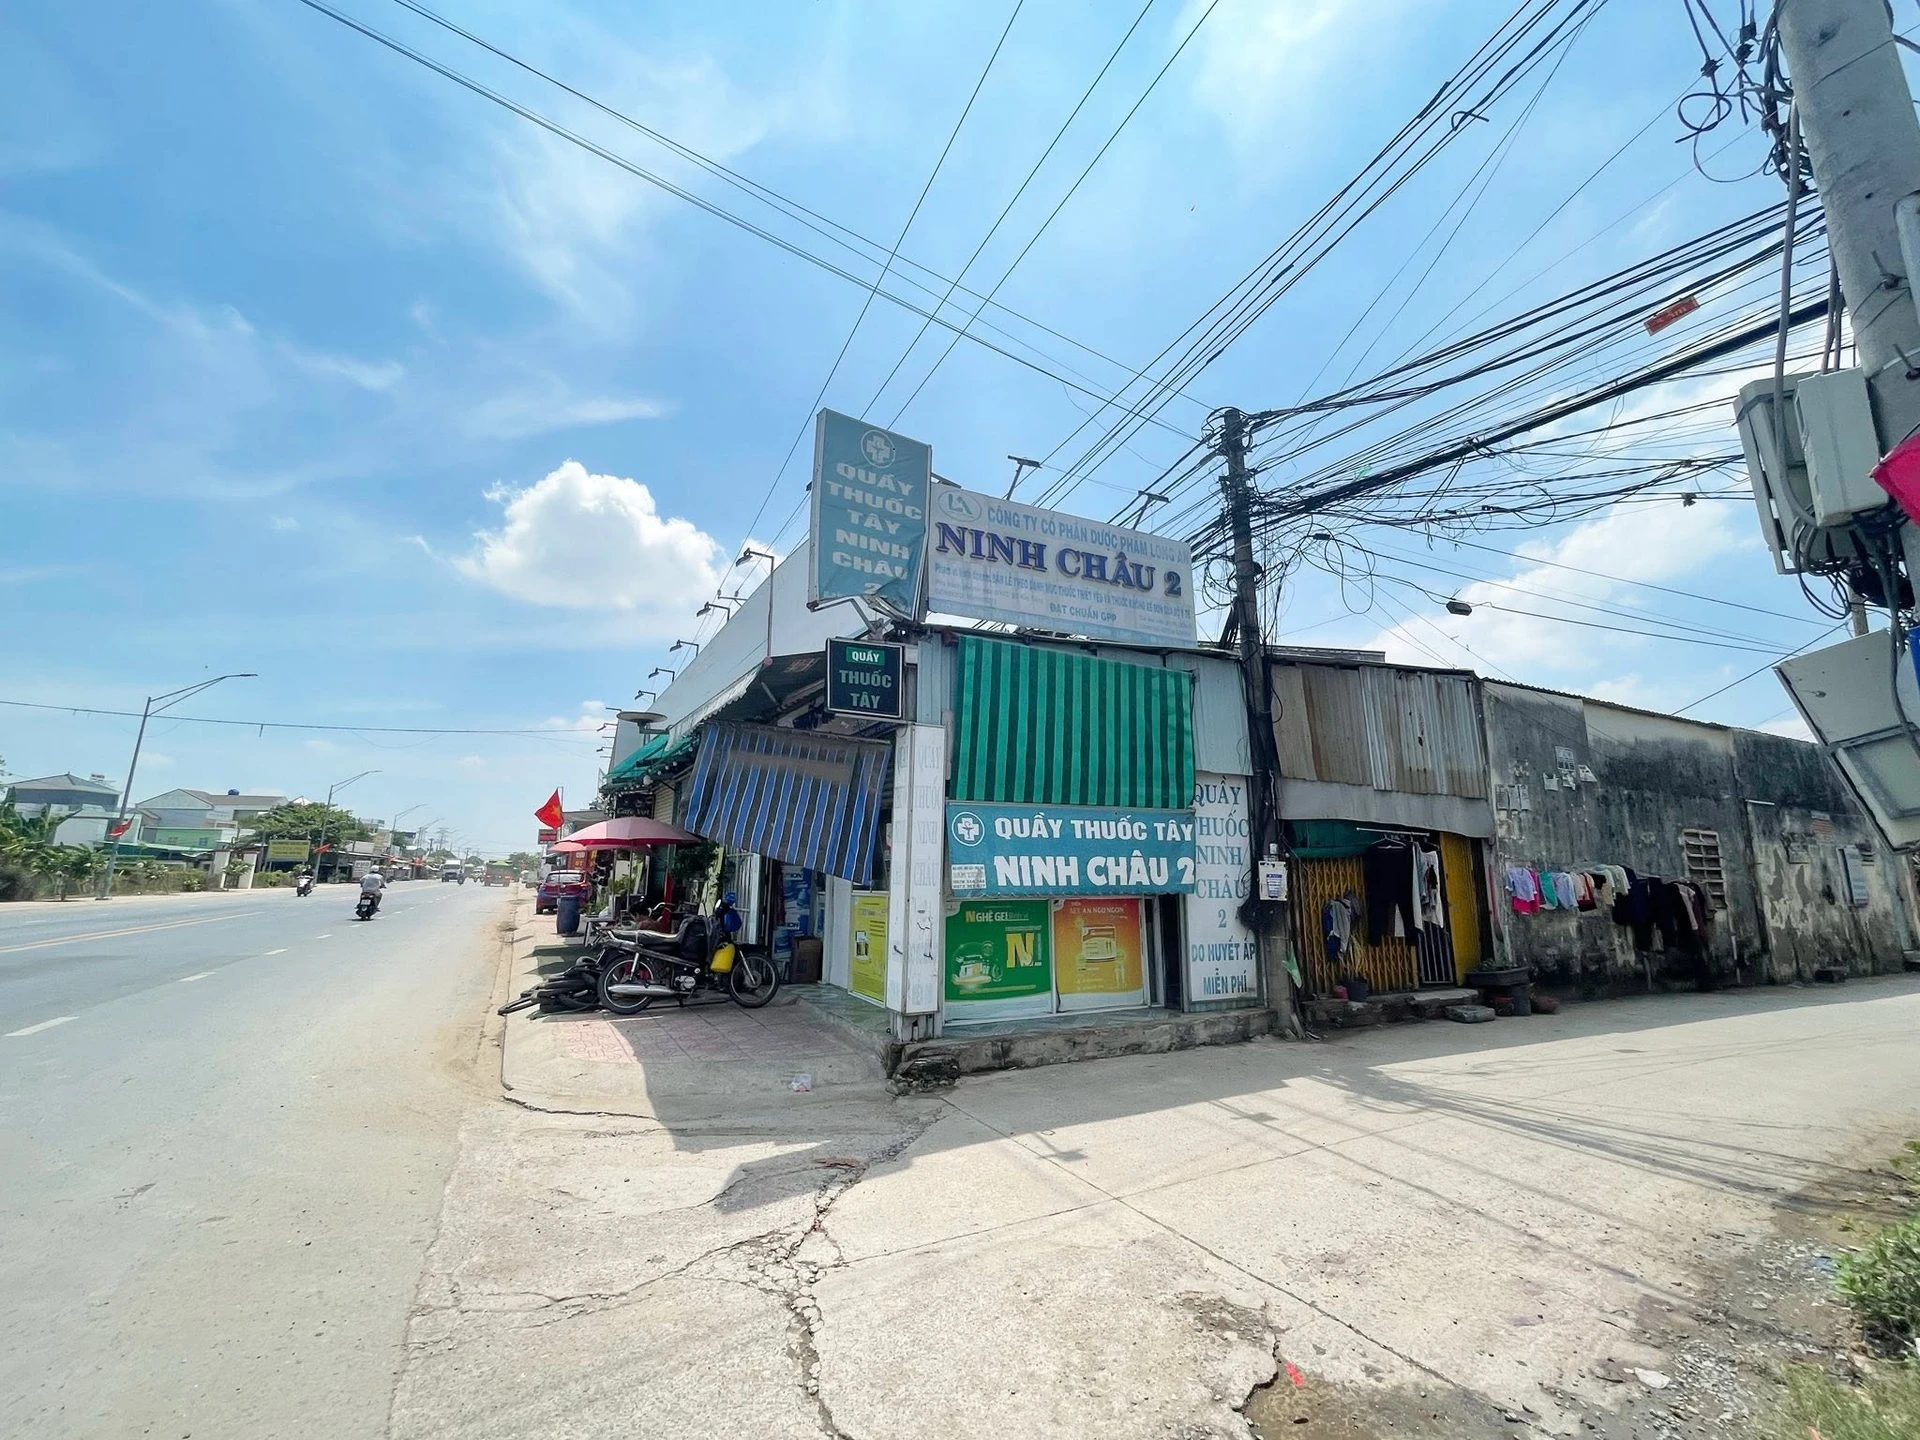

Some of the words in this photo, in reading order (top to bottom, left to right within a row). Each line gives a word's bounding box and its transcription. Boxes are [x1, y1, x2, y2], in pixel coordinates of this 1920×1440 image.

[825, 480, 923, 521] THUỐC
[847, 509, 901, 535] TÂY
[987, 506, 1020, 529] CÔNG
[1022, 513, 1037, 532] TY
[1091, 529, 1118, 551] DƯỢC
[1150, 545, 1175, 562] LONG
[1177, 549, 1191, 564] AN
[835, 529, 910, 560] NINH
[832, 551, 908, 580] CHÂU
[935, 522, 1048, 572] NINH
[1055, 548, 1156, 592] CHÂU
[1163, 571, 1182, 598] 2
[1101, 611, 1117, 622] GPP
[839, 669, 892, 688] THUỐC
[850, 691, 881, 709] TÂY
[1195, 775, 1241, 807] QUẦY
[995, 811, 1063, 840] QUẦY
[1070, 814, 1147, 841] THUỐC
[1154, 819, 1193, 842] TÂY
[1195, 809, 1249, 838] HUỐC
[994, 855, 1080, 887] NINH
[1087, 850, 1169, 887] CHÂU
[1177, 856, 1195, 885] 2
[1196, 845, 1242, 866] NINH
[1196, 874, 1246, 900] CHÂU
[1218, 909, 1227, 928] 2
[1208, 935, 1240, 961] HUYẾT
[1243, 936, 1256, 960] ÁP
[1230, 970, 1247, 993] PHÍ
